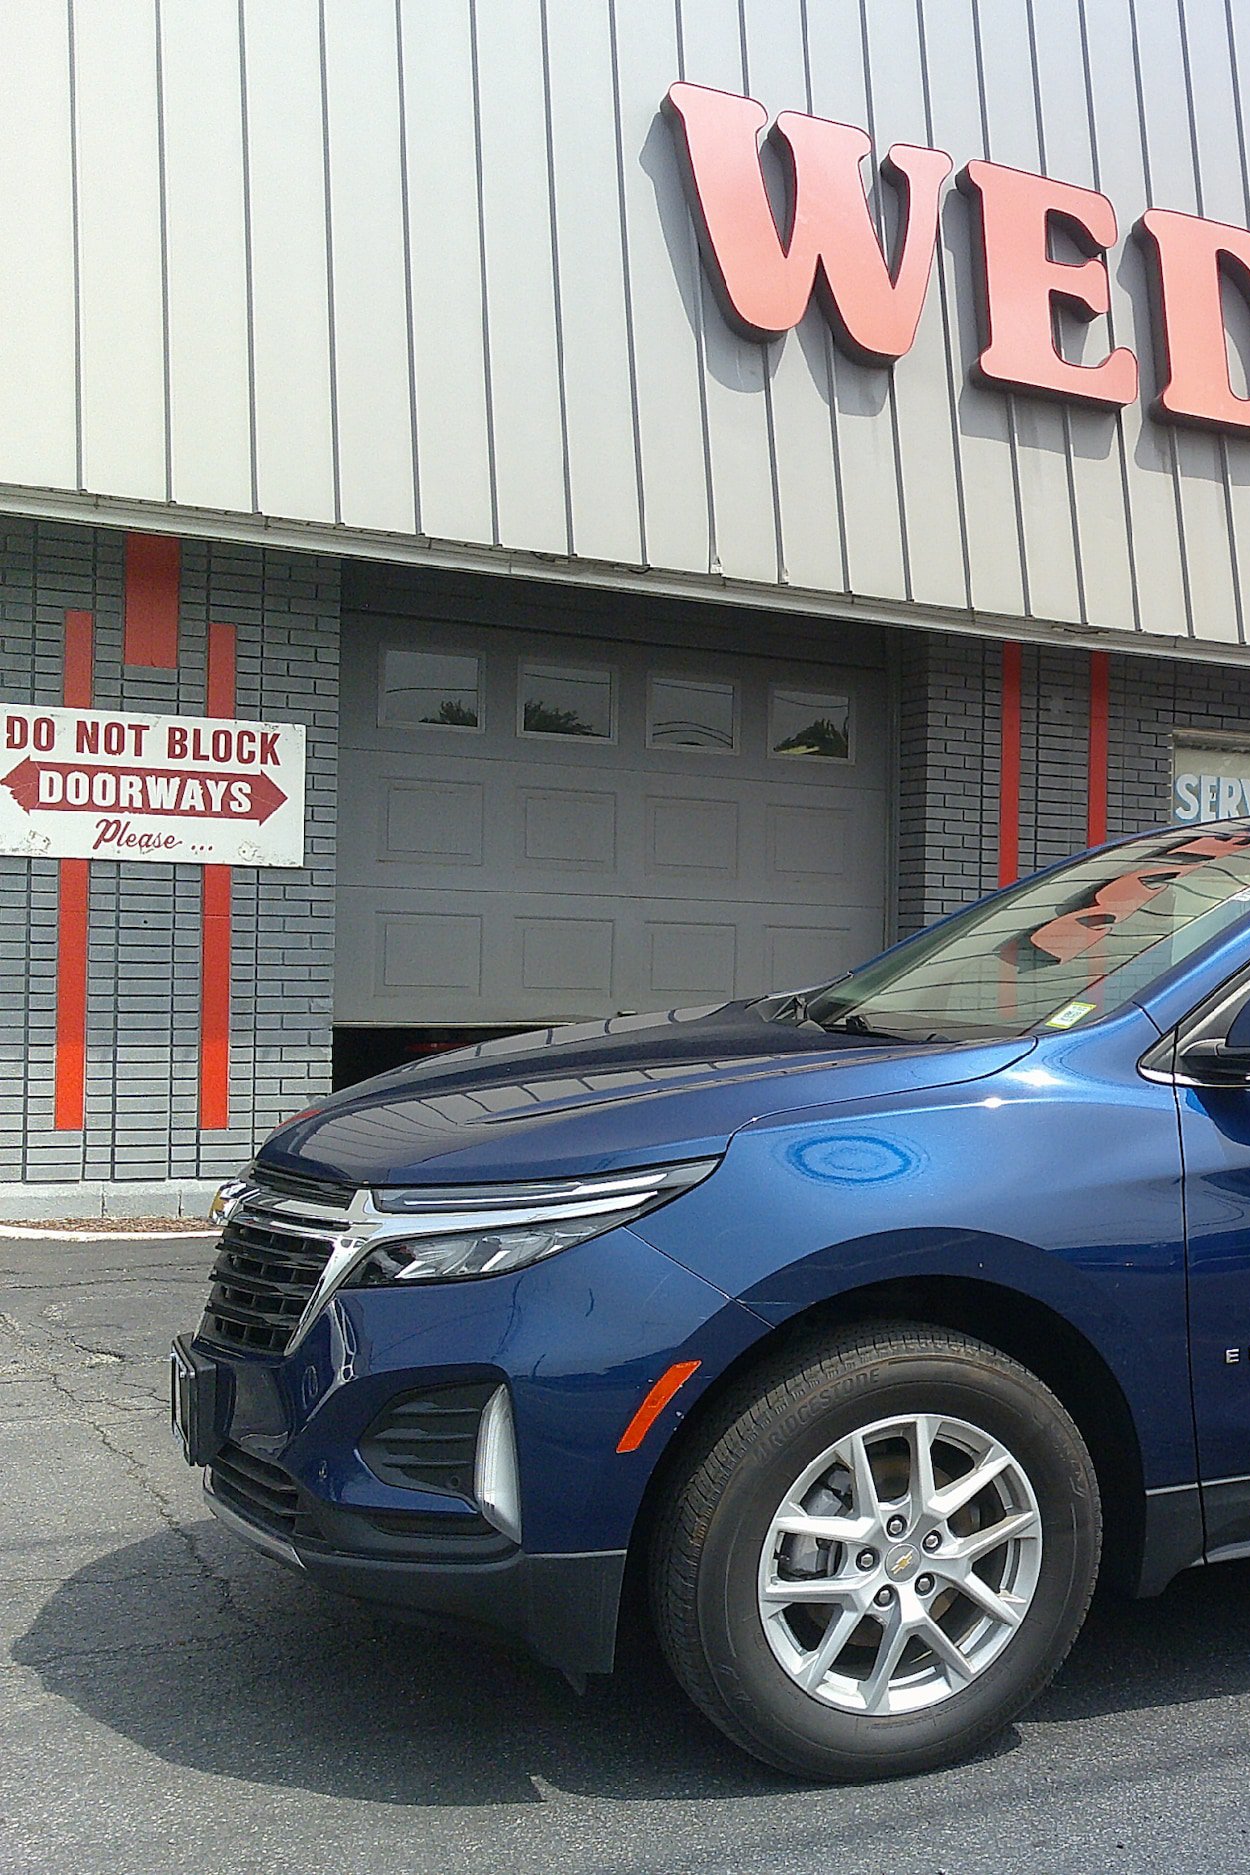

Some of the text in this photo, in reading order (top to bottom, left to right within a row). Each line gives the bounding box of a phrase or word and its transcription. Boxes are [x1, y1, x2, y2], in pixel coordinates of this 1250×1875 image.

[5, 715, 281, 766] DO NOT BLOCK
[38, 769, 252, 813] DOORWAYS
